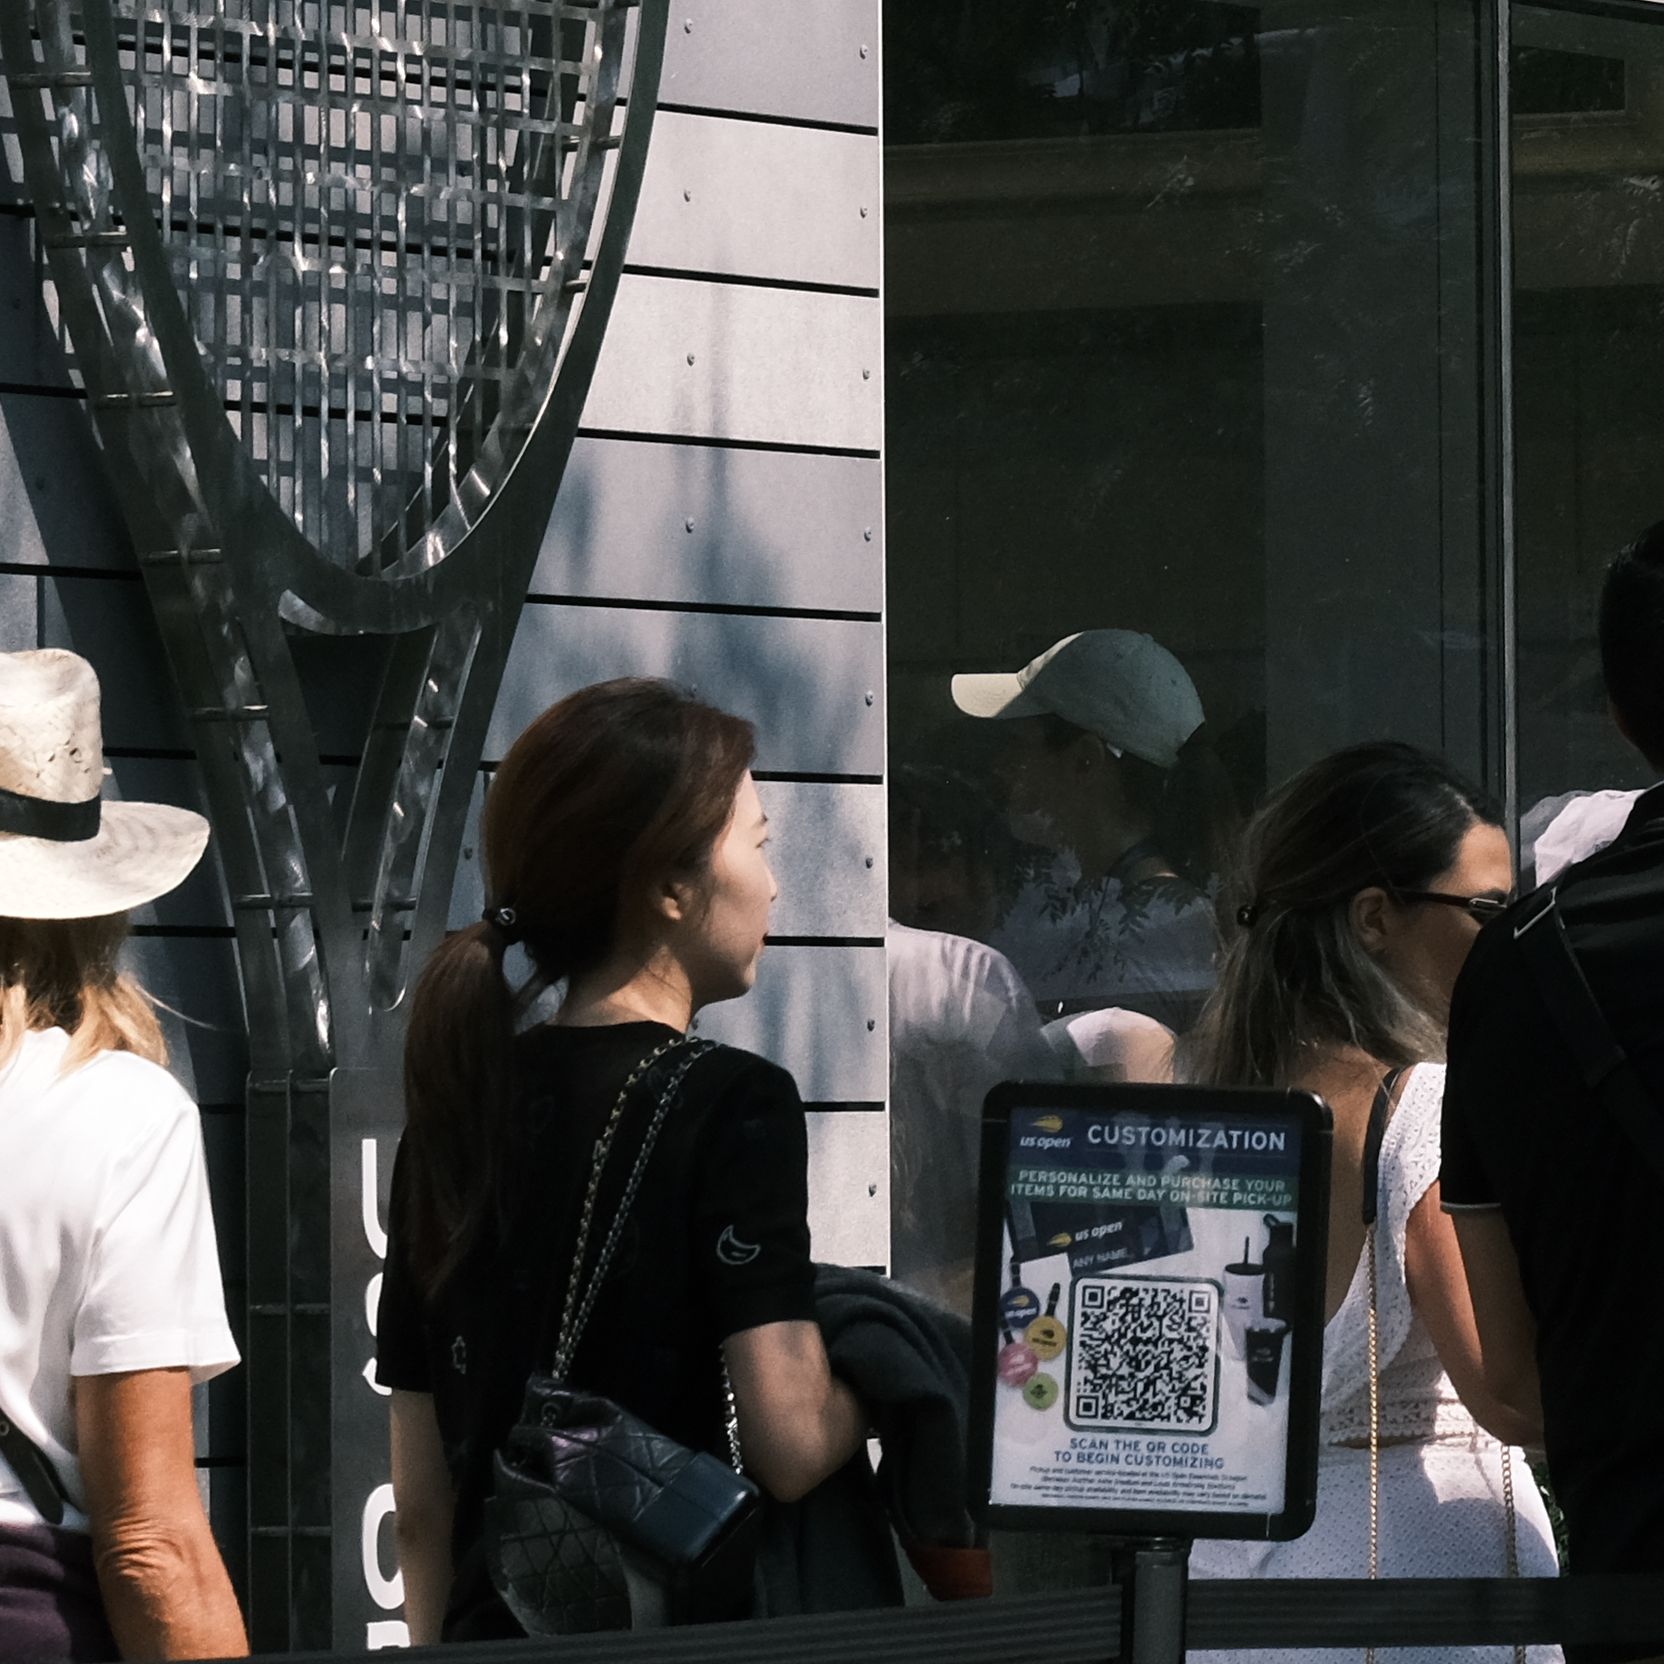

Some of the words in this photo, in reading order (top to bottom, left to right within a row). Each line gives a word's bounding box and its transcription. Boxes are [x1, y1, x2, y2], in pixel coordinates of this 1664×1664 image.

[1020, 1136, 1036, 1147] us
[1037, 1136, 1072, 1150] open
[1087, 1124, 1286, 1151] CUSTOMIZATION
[1018, 1170, 1121, 1186] PERSONALIZE
[1125, 1174, 1157, 1187] AND
[1161, 1176, 1240, 1191] PURCHASE
[1245, 1179, 1286, 1193] YOUR
[1011, 1183, 1054, 1197] ITEMS
[1059, 1185, 1088, 1198] FOR
[1092, 1186, 1133, 1200] SAME
[1137, 1188, 1167, 1201] DAY
[1170, 1189, 1228, 1204] ON-SITE
[1232, 1192, 1293, 1206] PICK-UP
[1070, 1438, 1108, 1450] SCAN
[1114, 1439, 1141, 1452] THE
[1146, 1441, 1166, 1453] QR
[1171, 1442, 1209, 1455] CODE
[1055, 1450, 1072, 1462] TO
[1076, 1452, 1120, 1464] BEGIN
[1124, 1454, 1225, 1469] CUSTOMIZING
